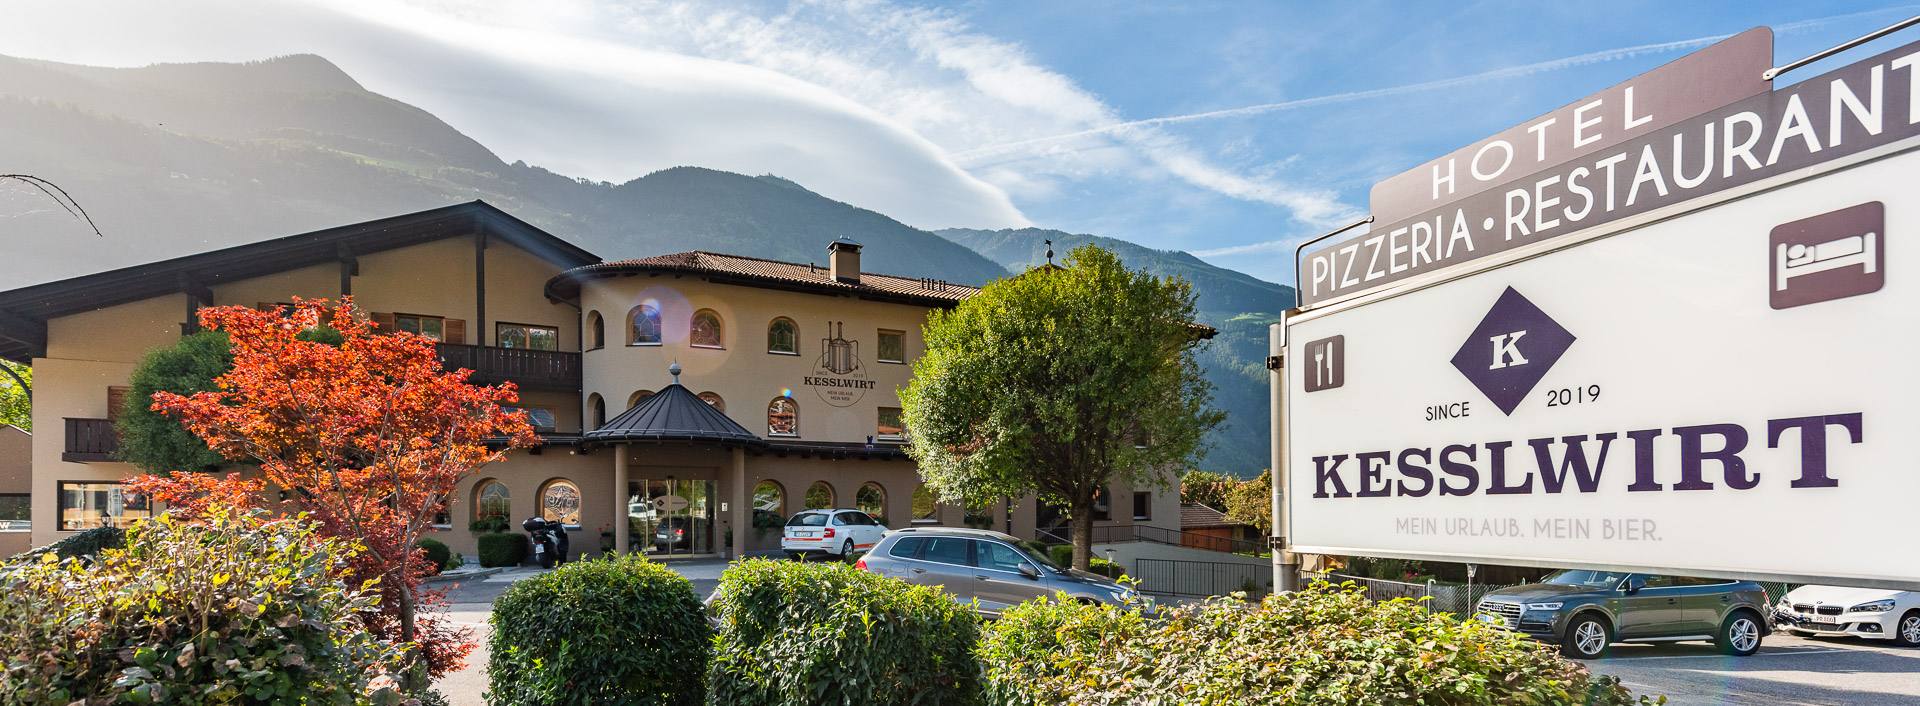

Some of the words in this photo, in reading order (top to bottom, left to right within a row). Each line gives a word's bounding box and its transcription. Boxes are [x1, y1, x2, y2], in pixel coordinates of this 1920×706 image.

[1432, 86, 1653, 201] HOTEL
[1311, 208, 1474, 297] PIZZERIA
[1505, 51, 1920, 241] RESTAURANT
[1489, 329, 1529, 370] K
[804, 376, 876, 389] KESSLWIRT
[1425, 401, 1470, 421] SINCE
[1547, 384, 1601, 408] 2019
[1312, 412, 1863, 498] KESSLWIRT
[1395, 517, 1437, 536] MEIN
[1445, 517, 1525, 538] URLAUB.
[1533, 518, 1591, 540] MEIN
[1601, 518, 1663, 542] BIER.
